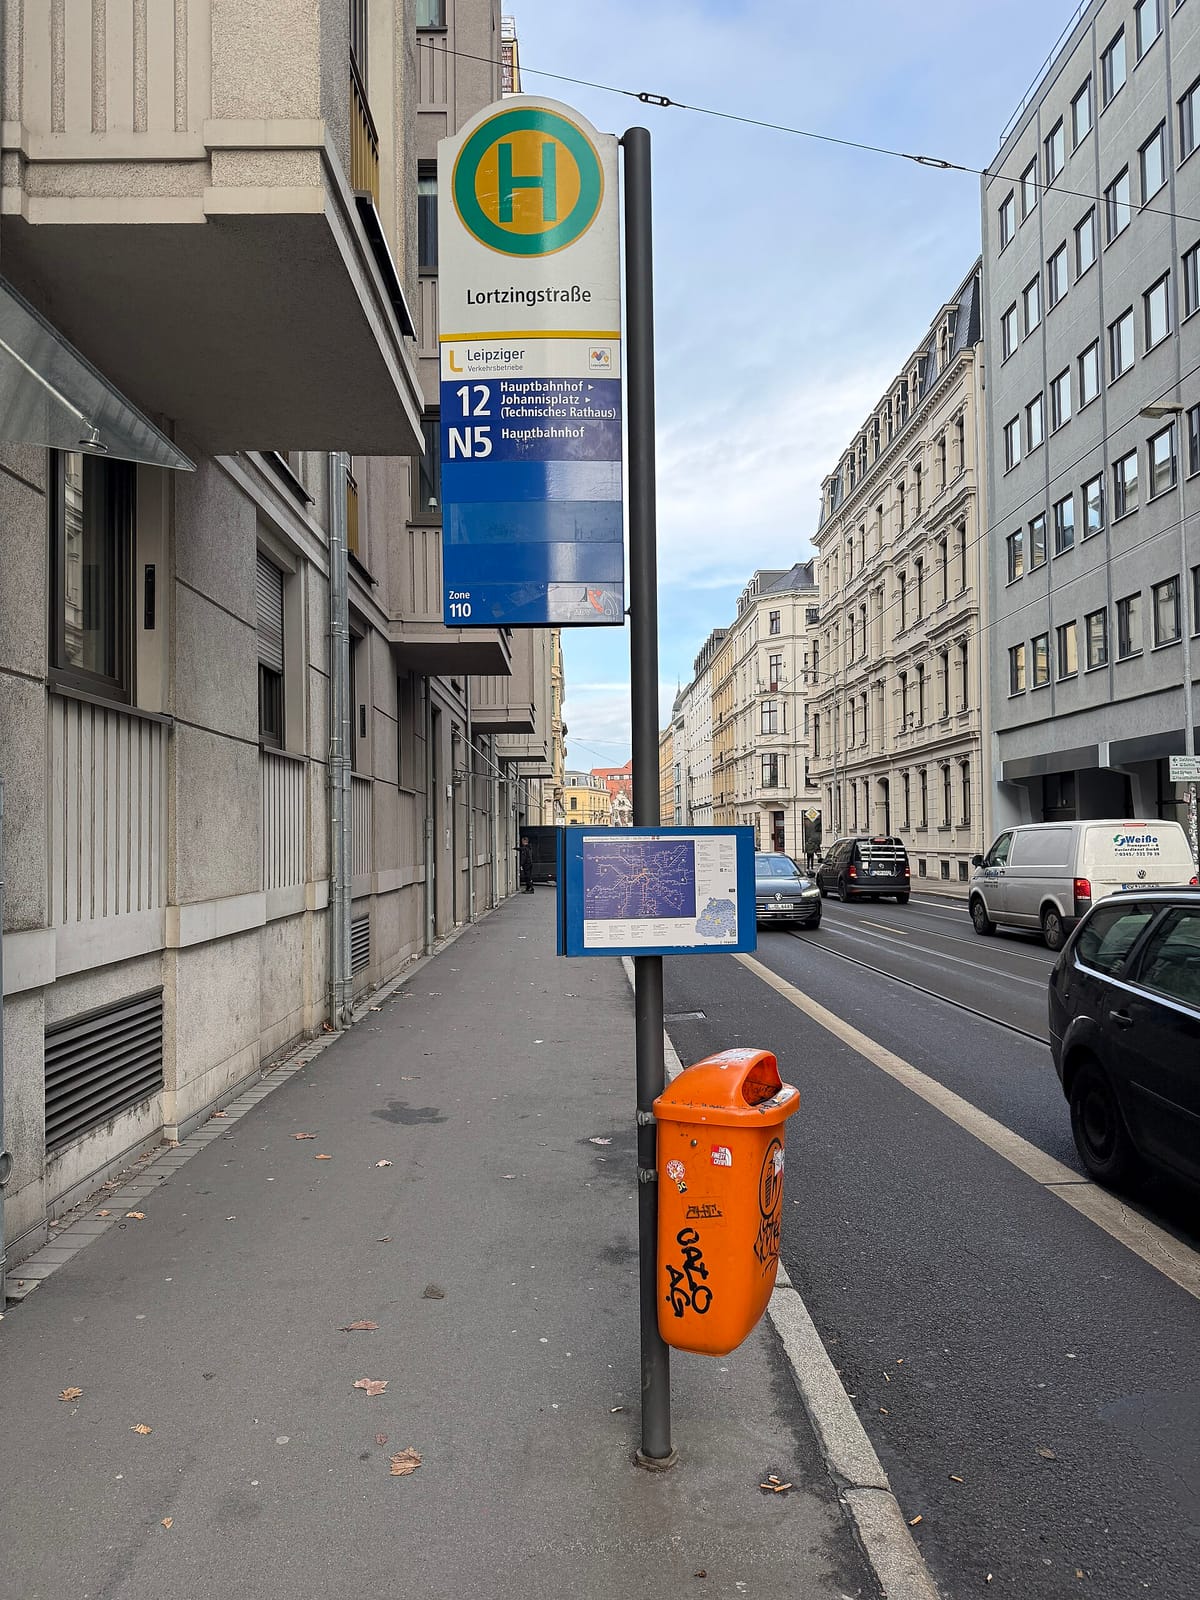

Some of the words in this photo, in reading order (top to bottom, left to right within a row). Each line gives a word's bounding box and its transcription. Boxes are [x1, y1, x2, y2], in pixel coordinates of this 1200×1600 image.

[497, 142, 557, 223] H
[467, 285, 592, 306] Lortzingstraße
[467, 348, 525, 363] Leipziger
[467, 364, 523, 372] Verkehrsbetriebe
[500, 381, 583, 394] Hauptbahnhof
[456, 384, 491, 417] 12
[500, 394, 580, 407] Johannisplatz
[500, 407, 567, 419] (Technisches
[570, 407, 616, 419] Rathaus)
[501, 427, 585, 440] Hauptbahnhof
[448, 425, 493, 459] N5
[448, 591, 471, 600] Zone
[449, 602, 472, 618] 110
[1125, 835, 1158, 843] Weiße
